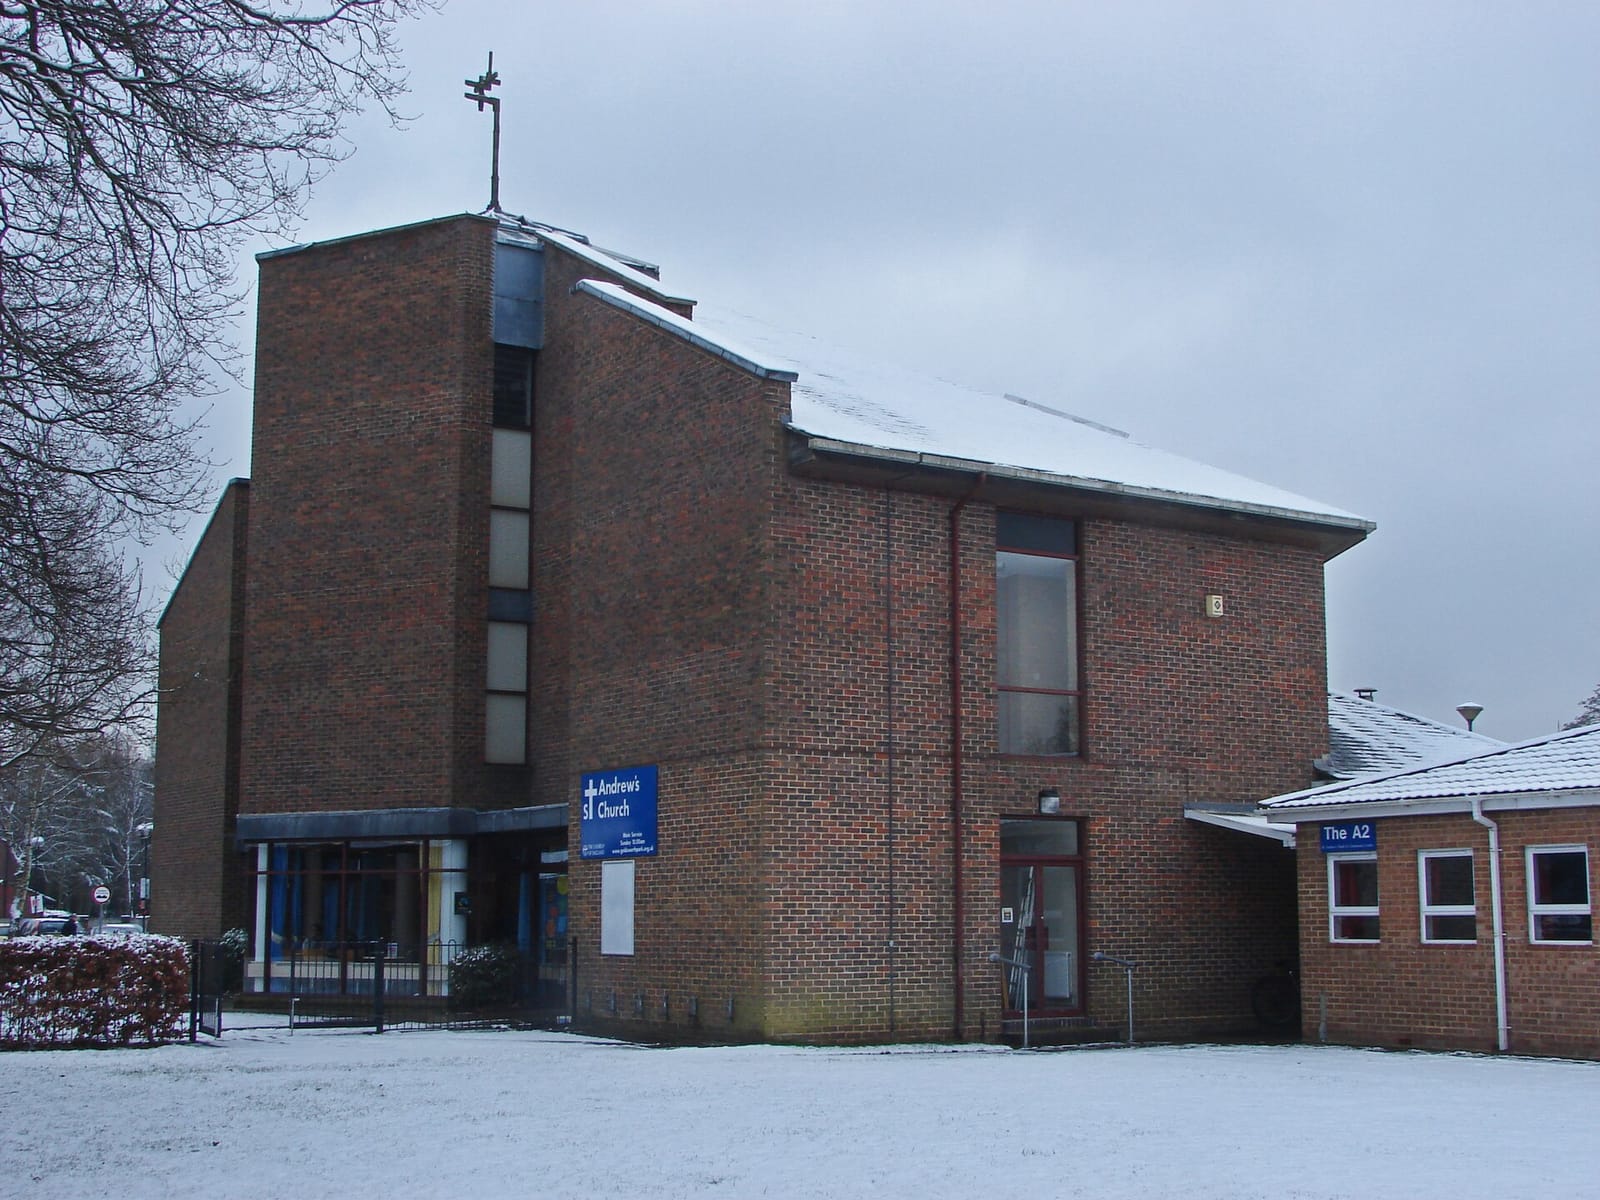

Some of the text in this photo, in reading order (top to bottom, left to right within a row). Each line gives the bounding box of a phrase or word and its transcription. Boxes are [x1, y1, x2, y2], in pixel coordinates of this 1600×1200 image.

[598, 775, 640, 796] Andrew's
[598, 798, 630, 819] Church
[1323, 824, 1370, 840] The A2
